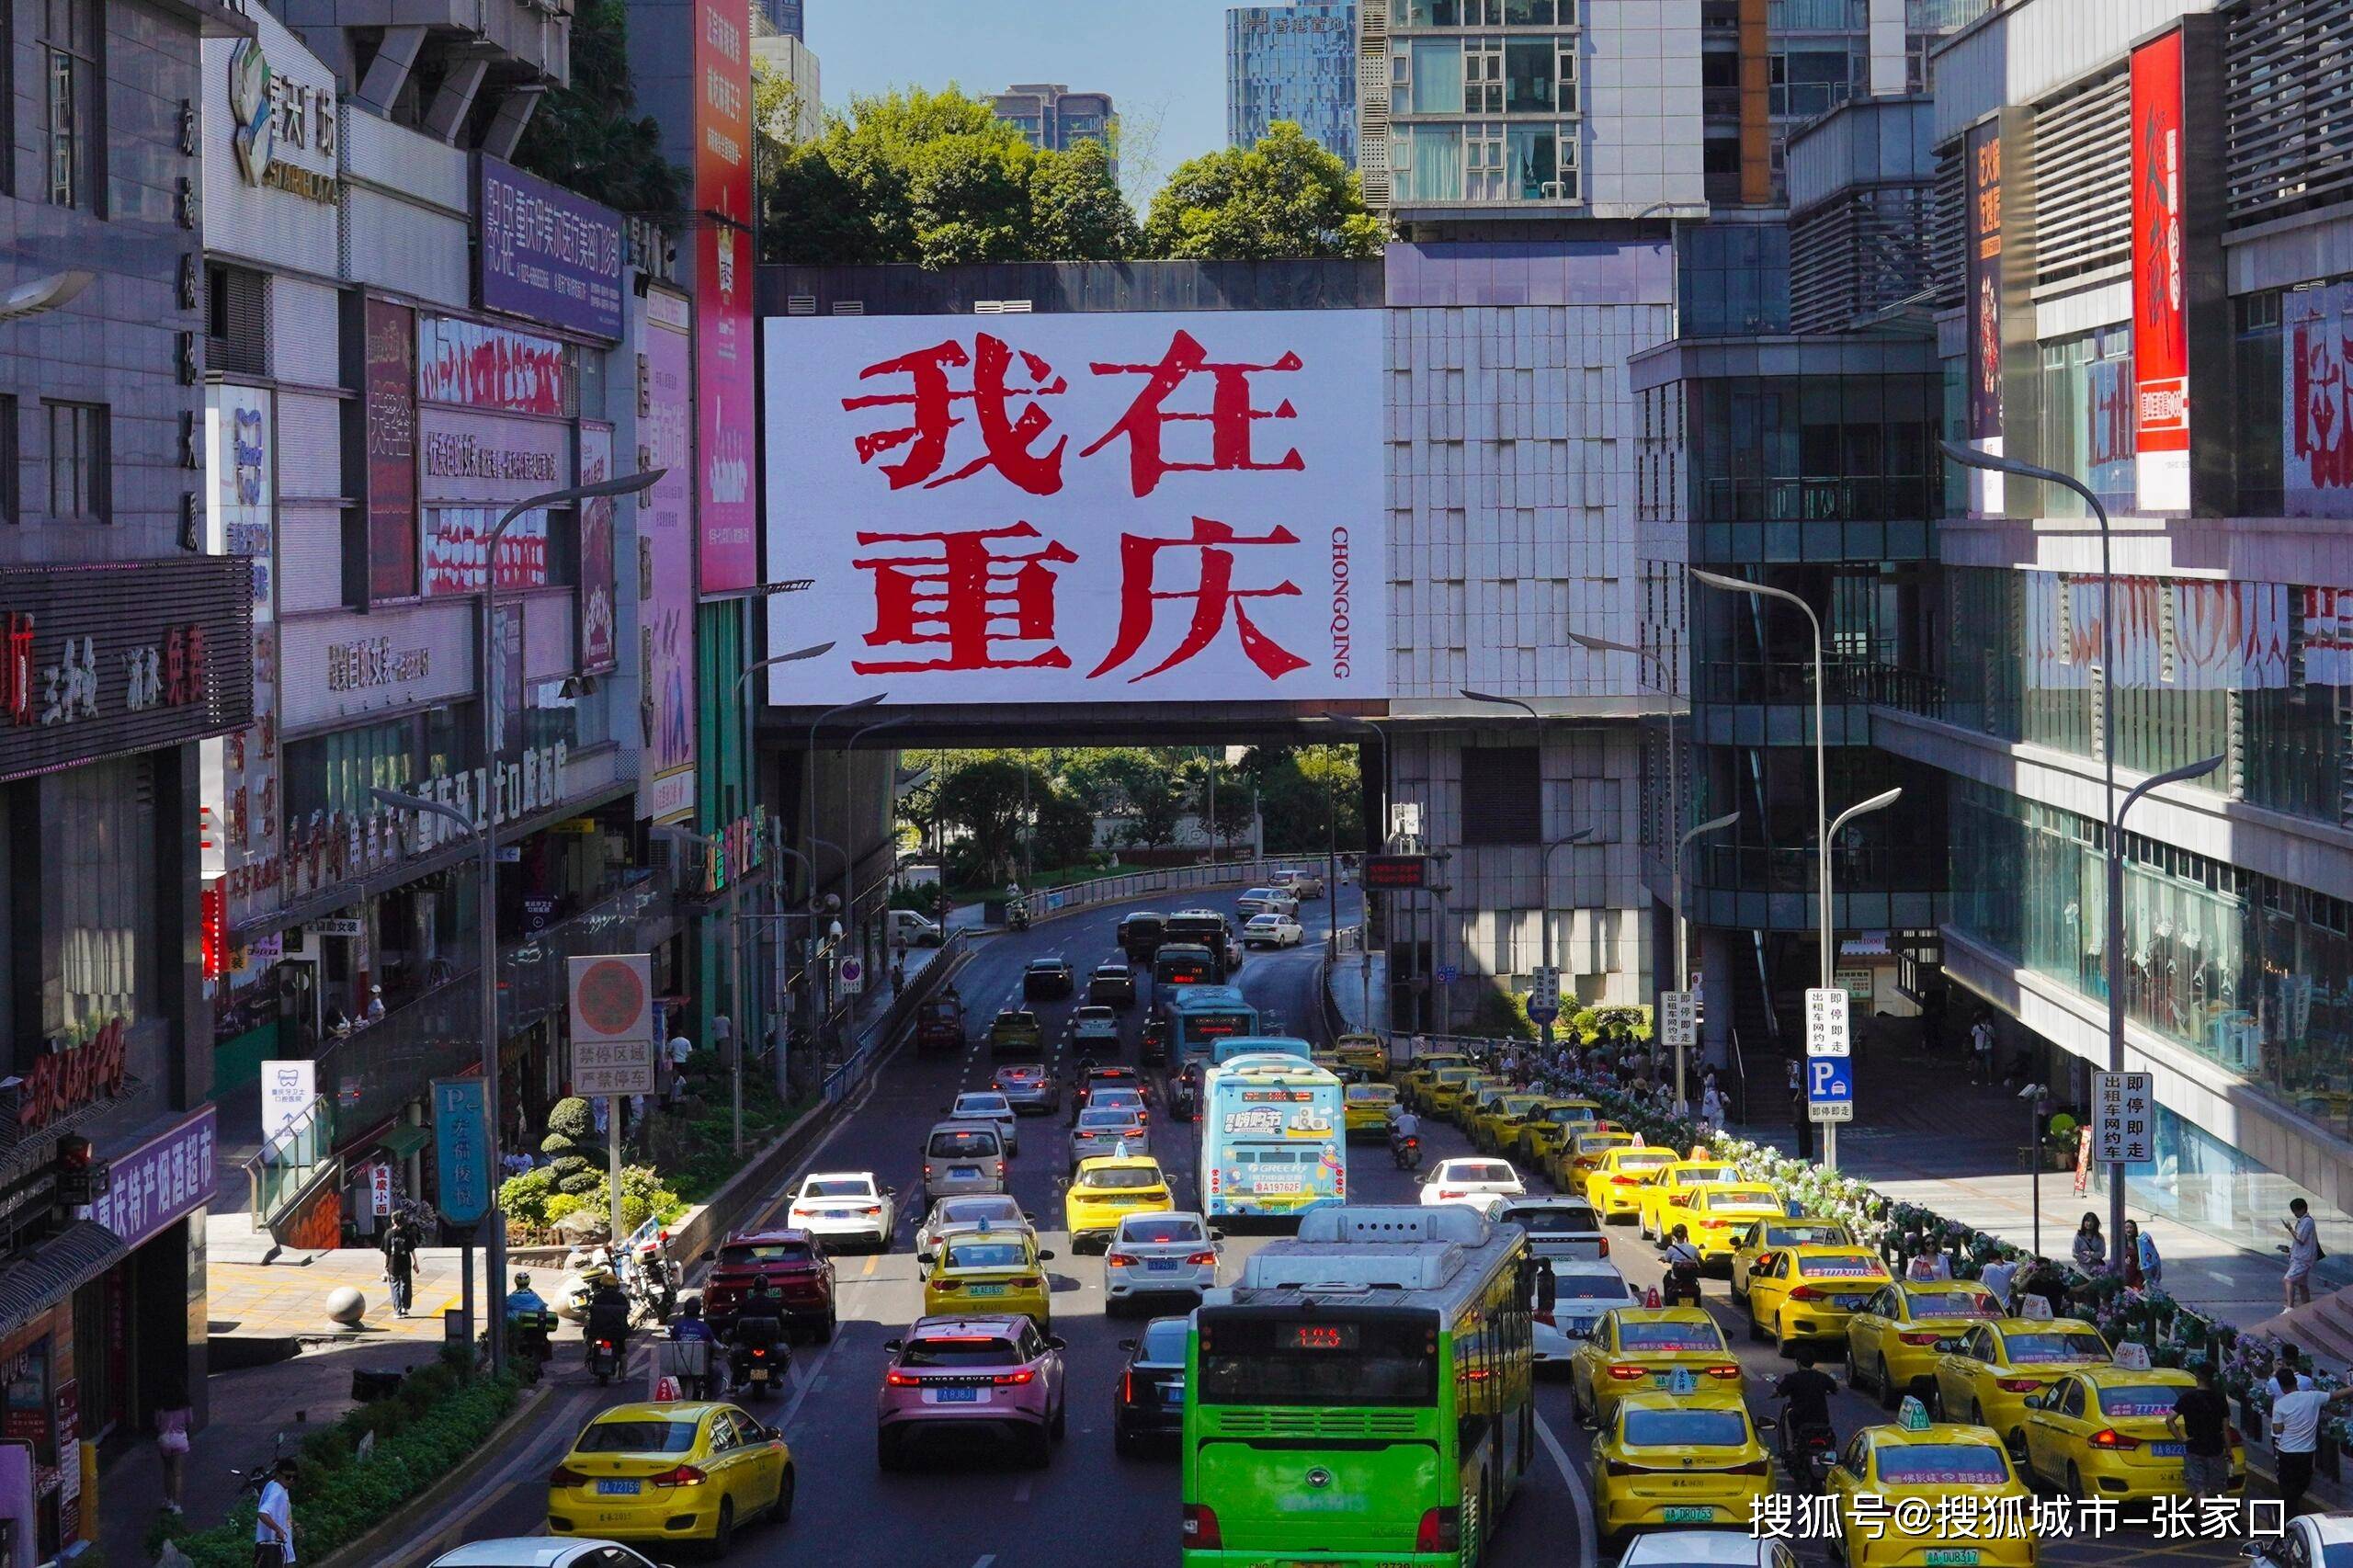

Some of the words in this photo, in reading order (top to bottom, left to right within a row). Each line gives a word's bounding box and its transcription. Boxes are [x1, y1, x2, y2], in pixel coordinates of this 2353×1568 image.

[842, 329, 1305, 498] 我在
[851, 516, 1313, 684] 重庆
[1330, 526, 1351, 680] CHONGQING
[1666, 994, 1678, 1043] 出租车网约车
[1680, 993, 1691, 1042] 即停即走
[1812, 992, 1824, 1052] 出租车网约车
[1830, 992, 1844, 1053] 即停即走
[579, 1044, 645, 1064] 禁停区域
[446, 1088, 464, 1114] P
[580, 1070, 646, 1089] 严禁停车
[1812, 1062, 1835, 1096] P
[1812, 1106, 1850, 1118] 即停即走
[2104, 1075, 2121, 1159] 出租车网约车
[2126, 1075, 2144, 1159] 即停即走
[1260, 1163, 1291, 1173] GREE
